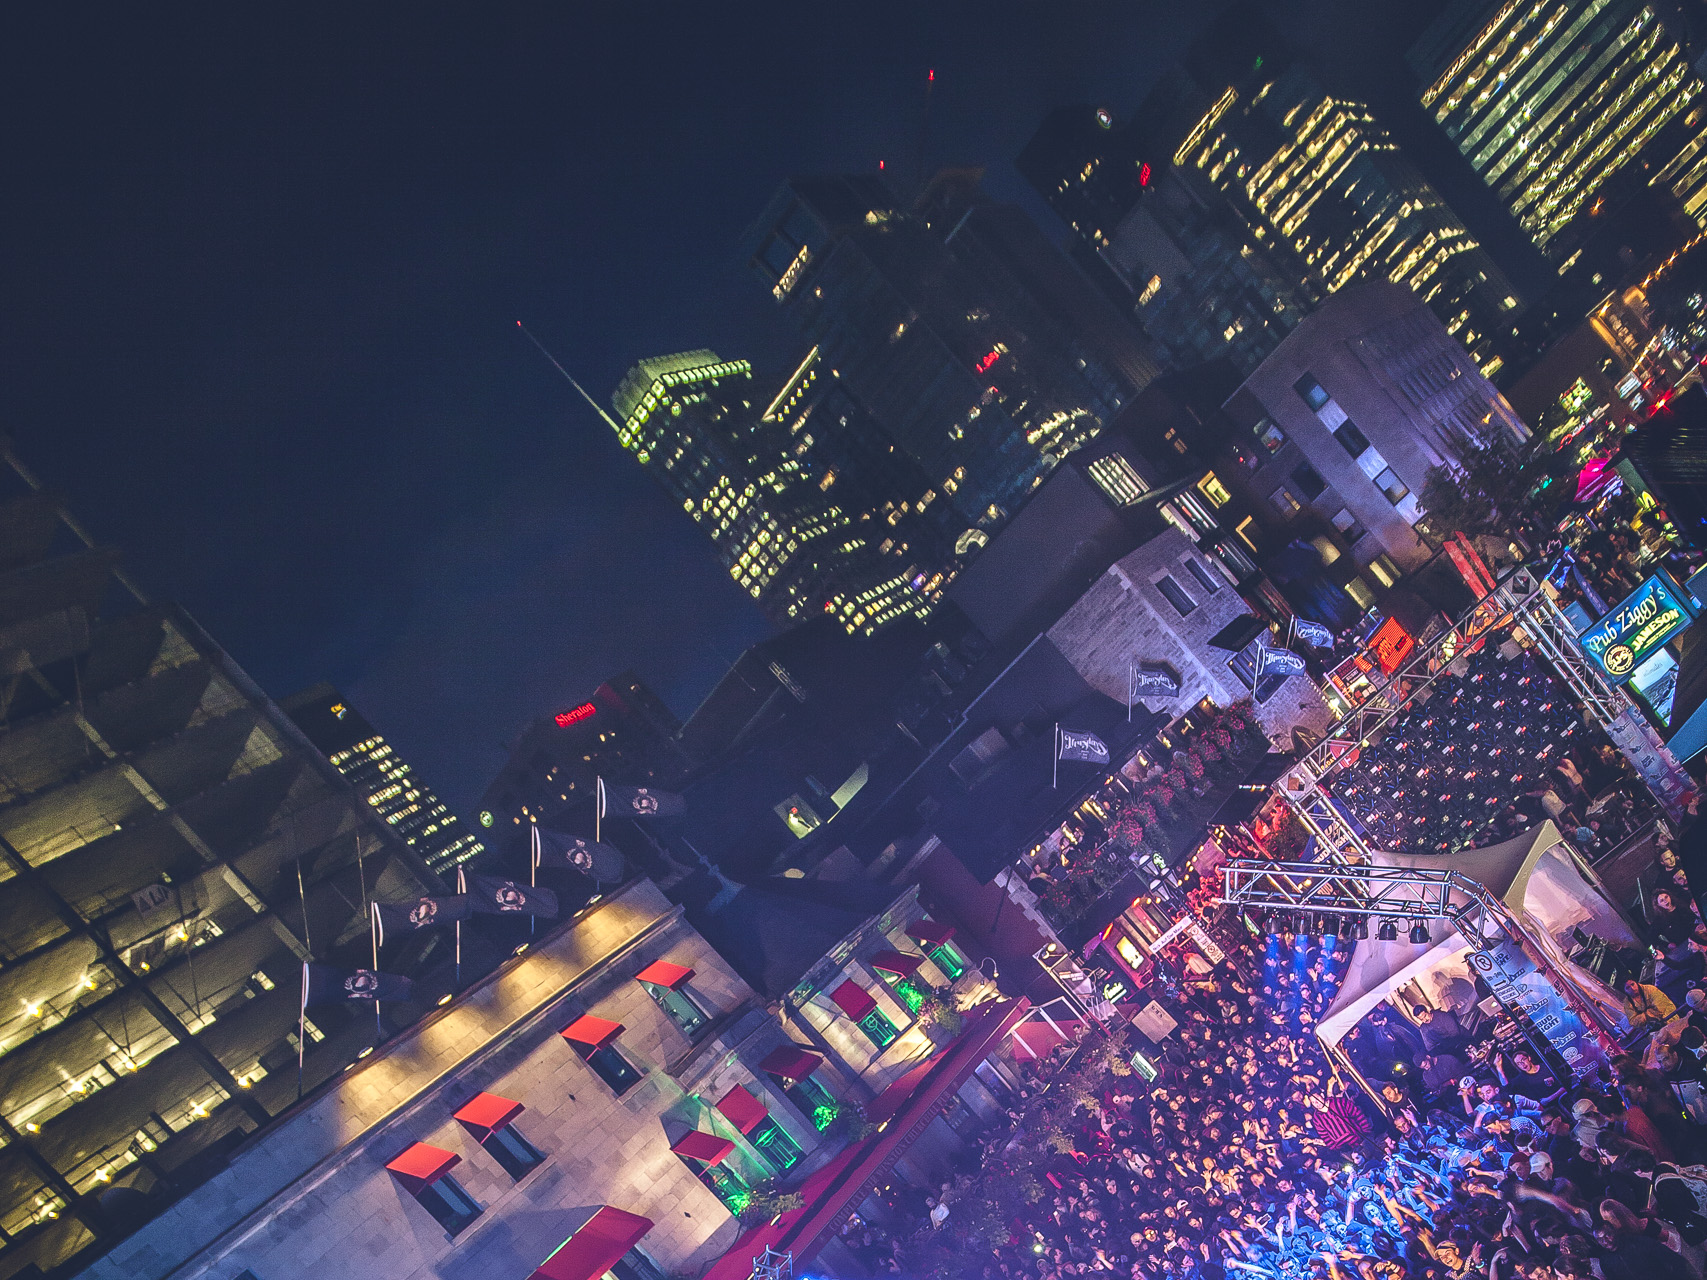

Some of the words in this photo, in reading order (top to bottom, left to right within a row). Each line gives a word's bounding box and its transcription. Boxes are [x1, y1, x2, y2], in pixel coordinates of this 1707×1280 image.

[1590, 621, 1617, 653] Pub
[1616, 586, 1666, 633] Ziggy's
[1631, 608, 1680, 651] JAMESON
[555, 702, 596, 727] Sheraton
[1541, 1016, 1560, 1033] IGHT
